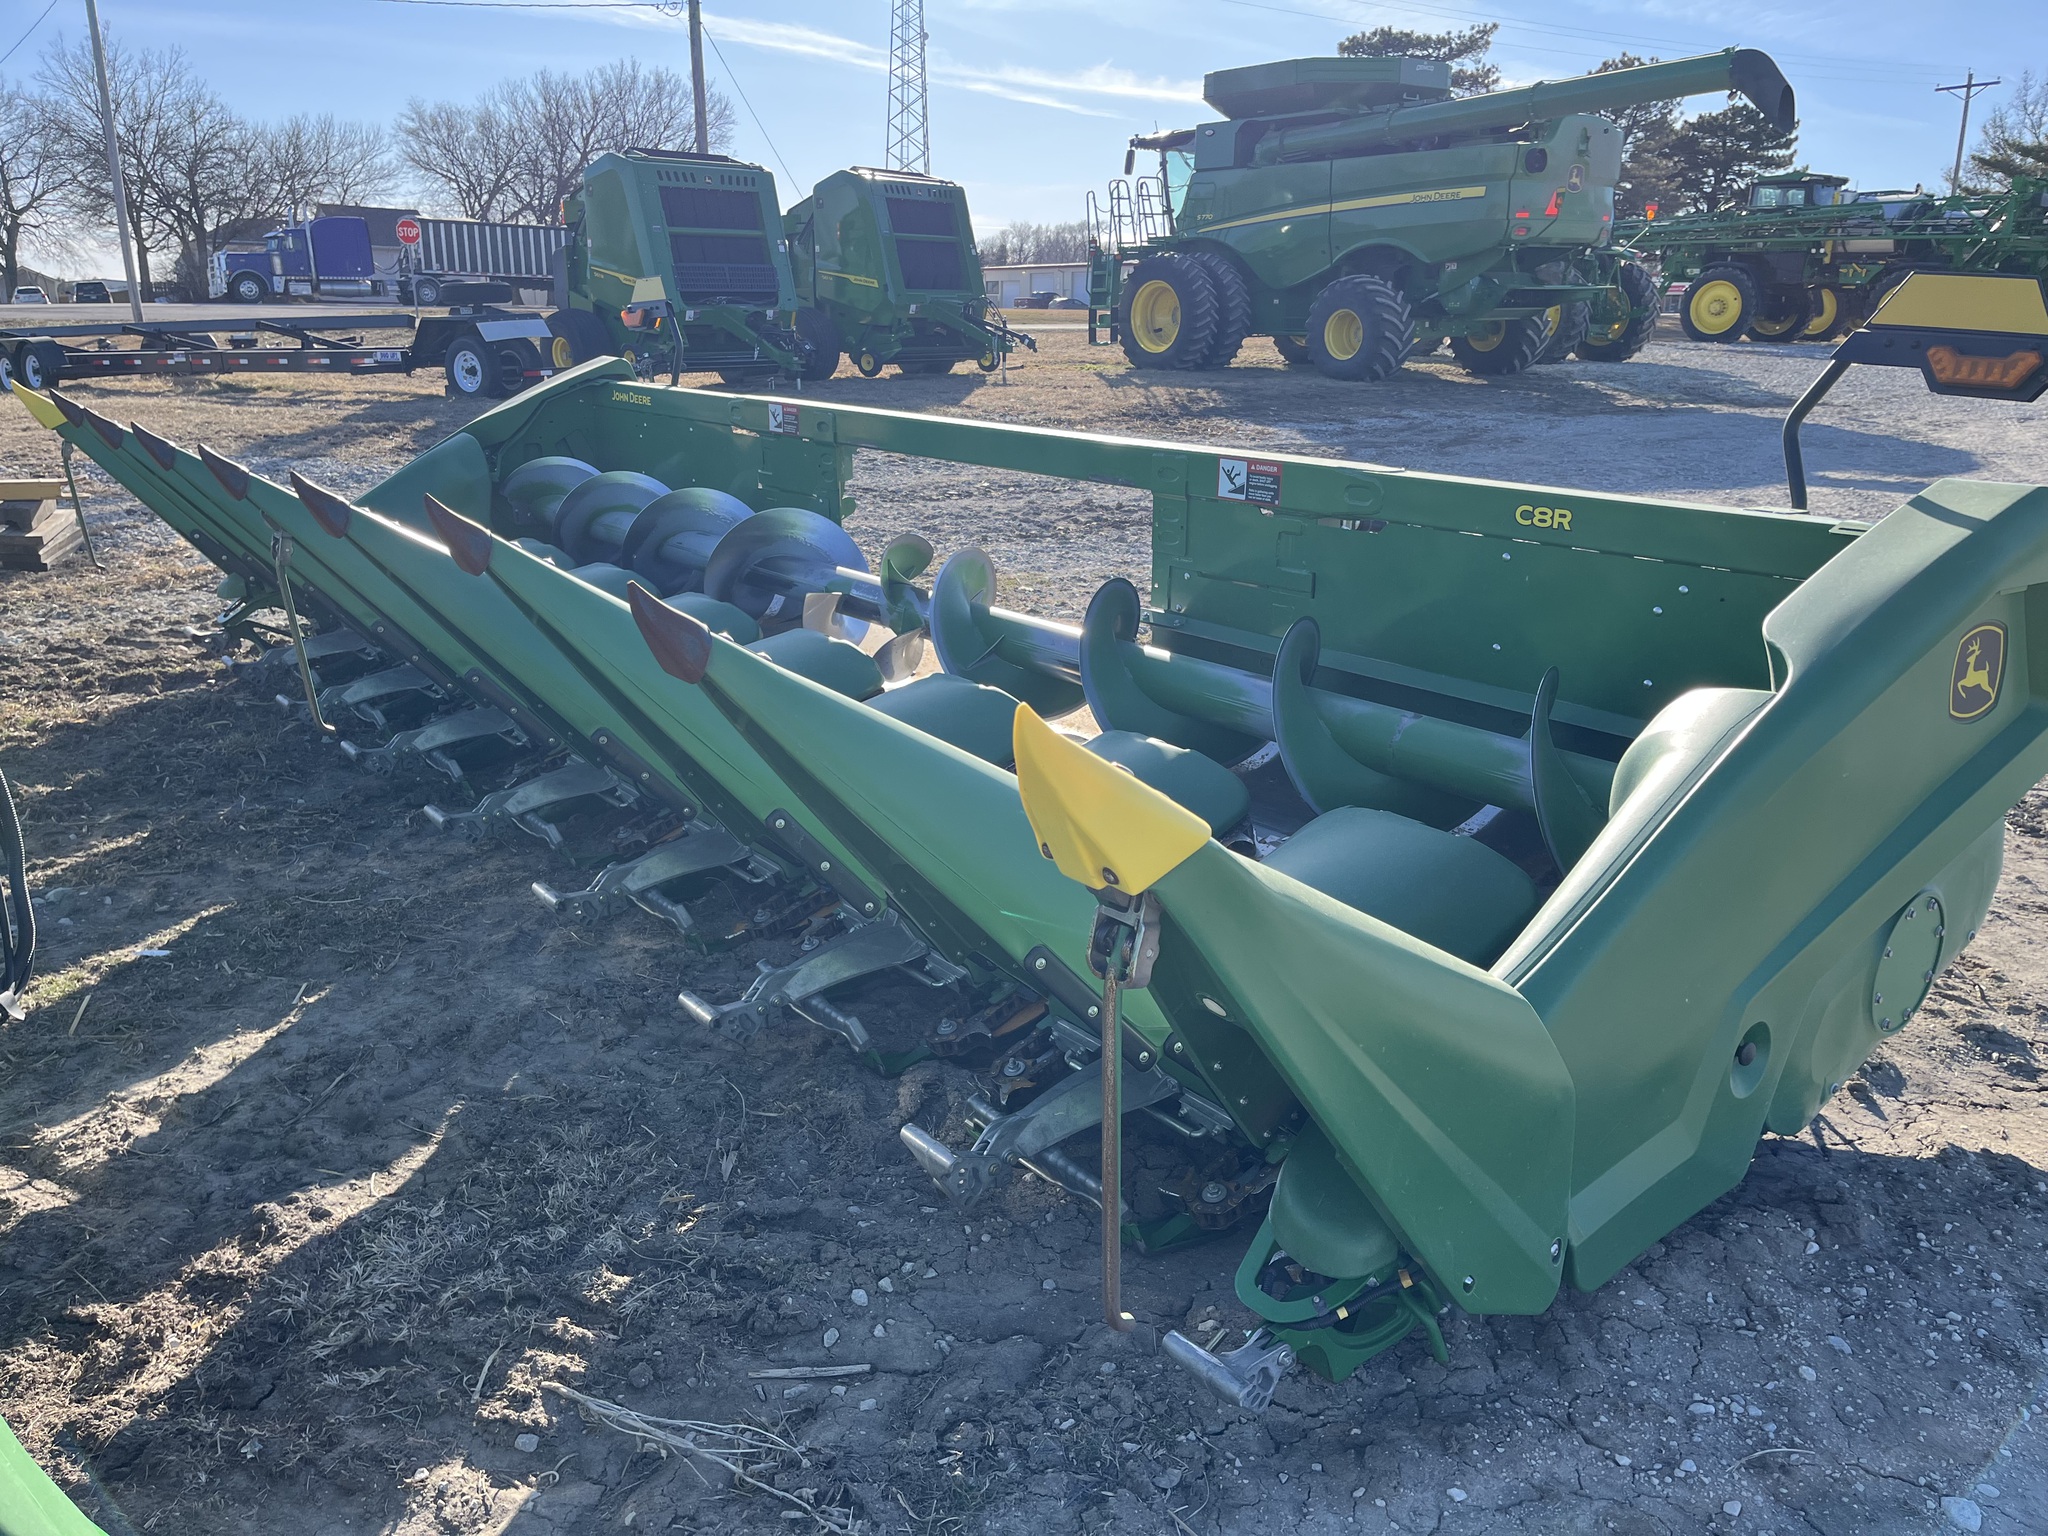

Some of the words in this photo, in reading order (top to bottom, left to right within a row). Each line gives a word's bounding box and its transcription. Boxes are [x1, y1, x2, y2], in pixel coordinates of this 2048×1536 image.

[1411, 193, 1433, 204] JOHN
[1434, 191, 1462, 201] DEERE
[398, 227, 418, 237] STOP
[612, 390, 629, 402] JOHN
[629, 391, 652, 406] DEERE
[1515, 505, 1572, 530] C8R
